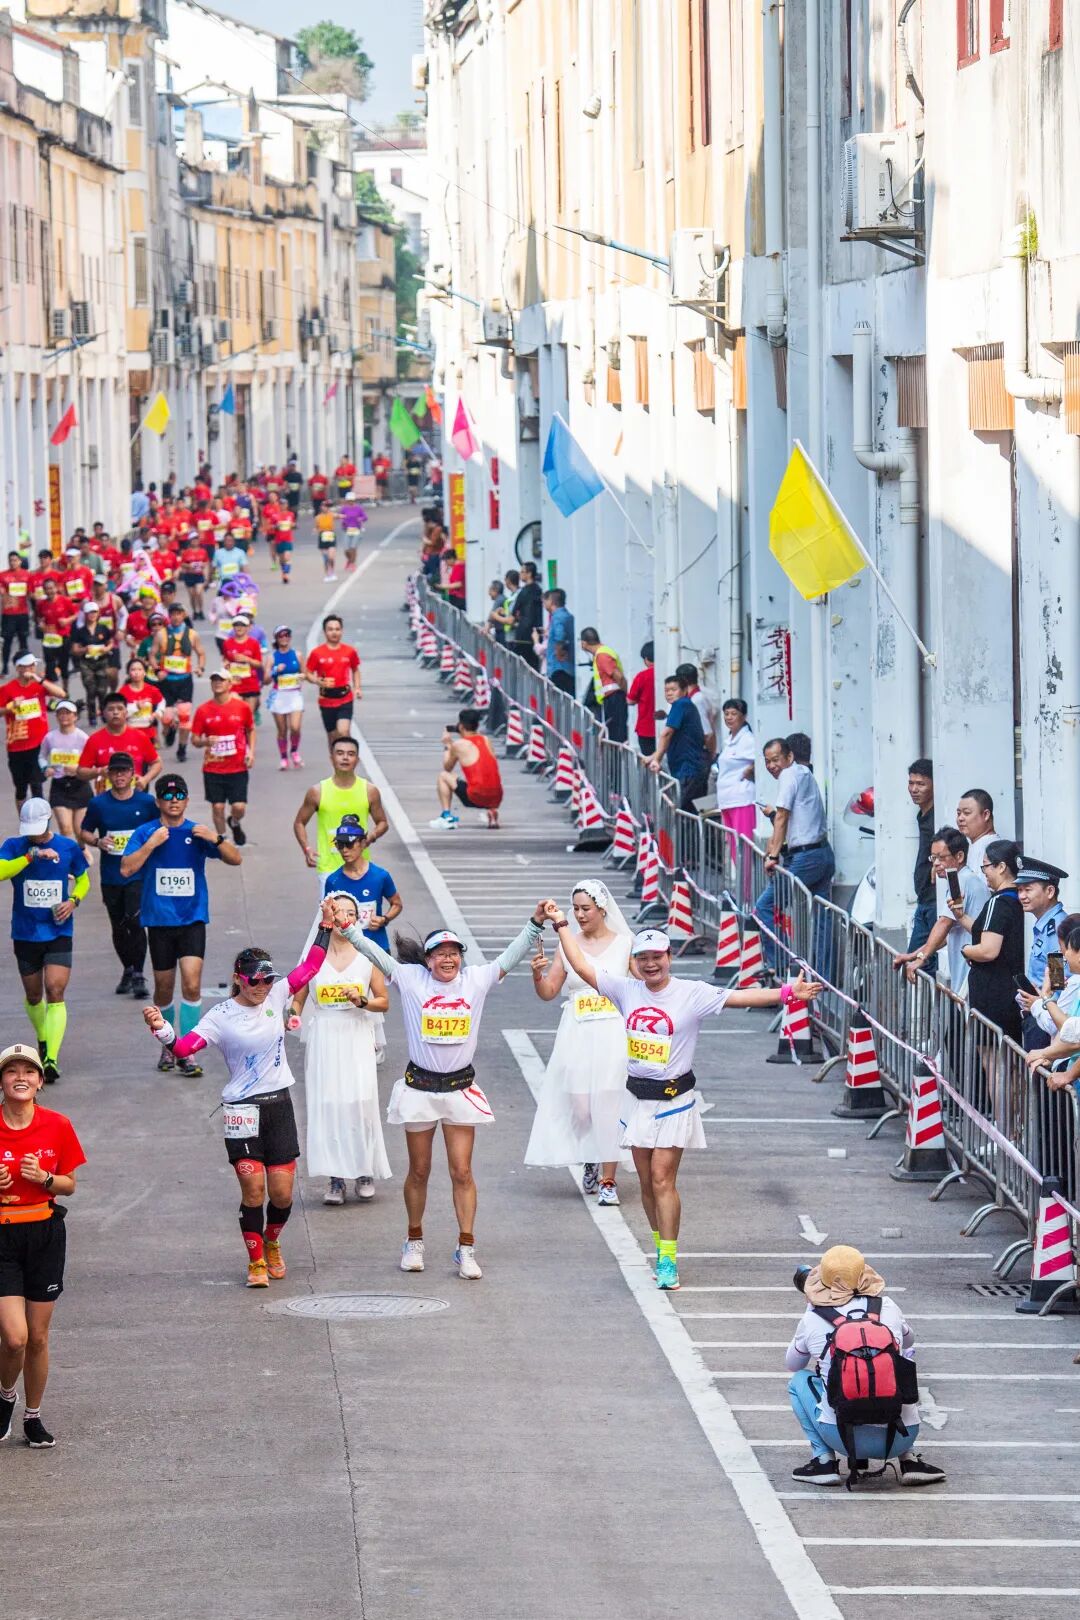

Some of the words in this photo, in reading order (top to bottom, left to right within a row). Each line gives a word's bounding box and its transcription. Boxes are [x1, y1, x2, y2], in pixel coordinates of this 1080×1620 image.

[160, 876, 190, 886] C1961
[27, 887, 58, 897] C0651
[320, 985, 360, 998] A22
[426, 1018, 466, 1031] B4173
